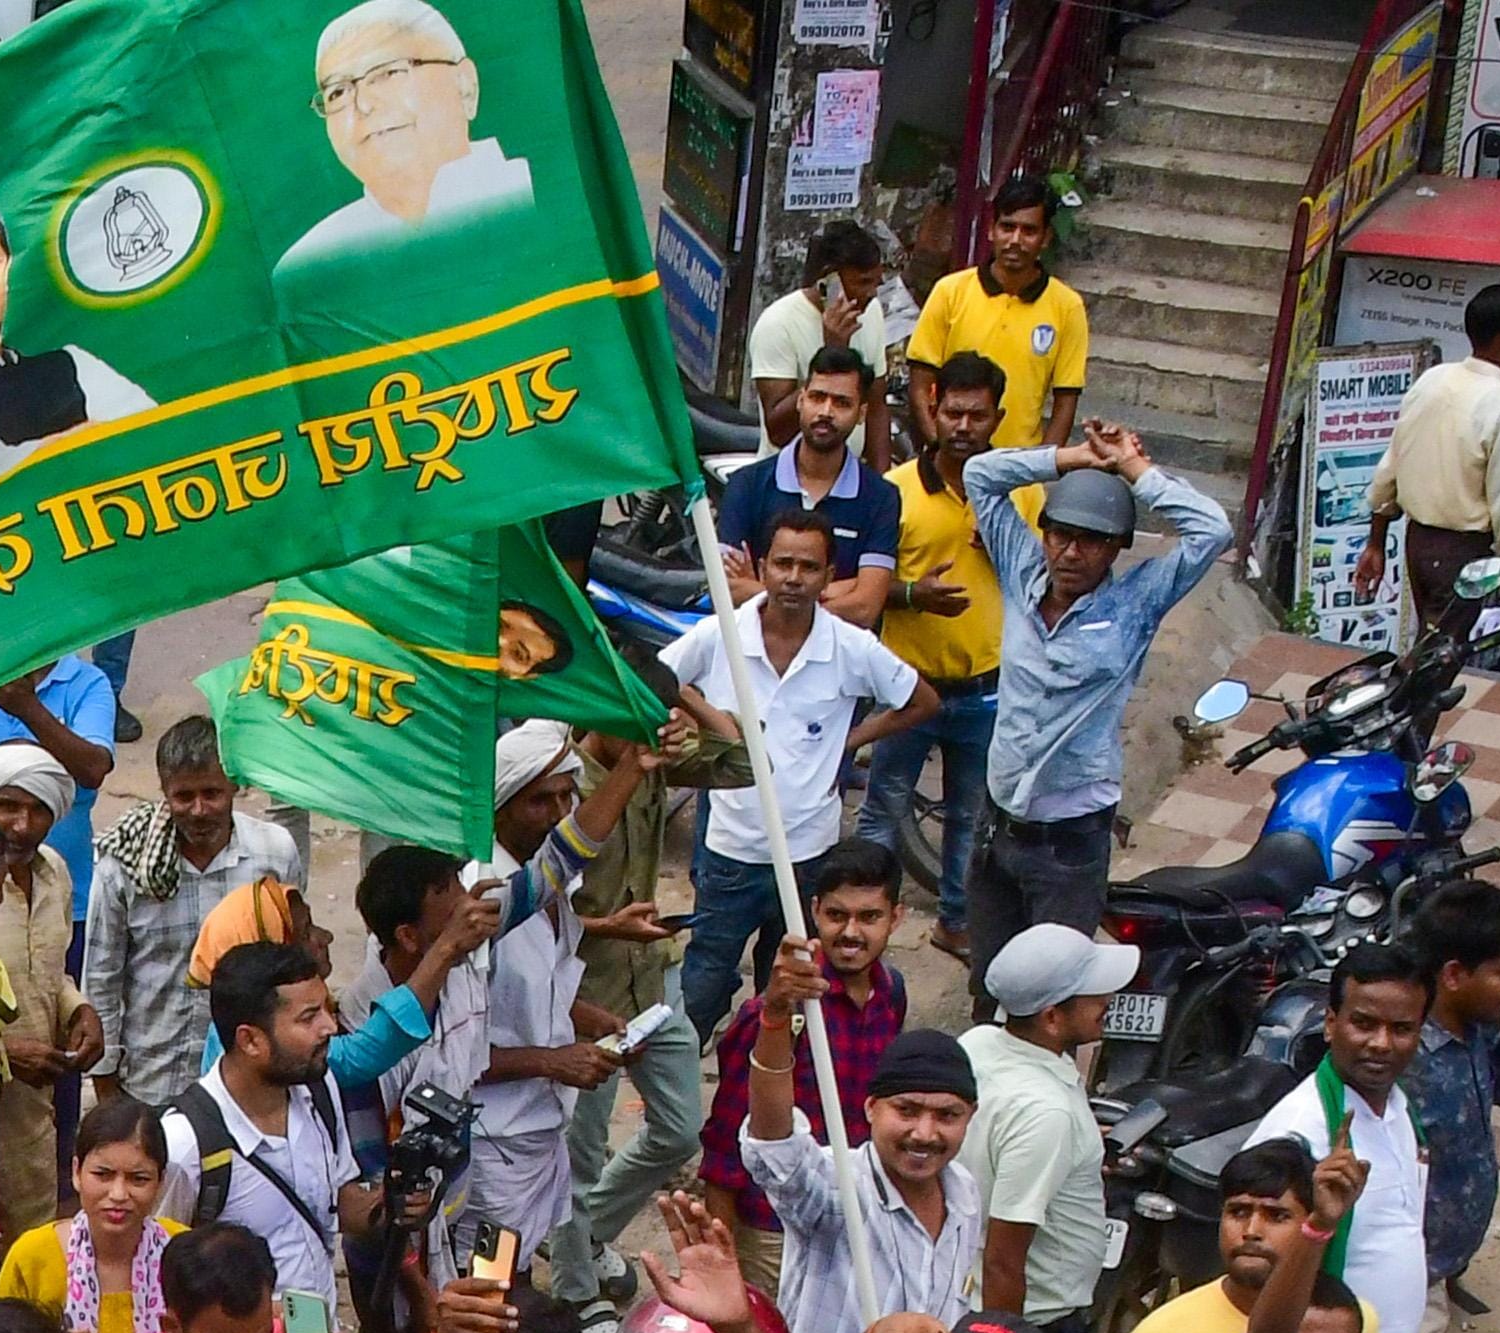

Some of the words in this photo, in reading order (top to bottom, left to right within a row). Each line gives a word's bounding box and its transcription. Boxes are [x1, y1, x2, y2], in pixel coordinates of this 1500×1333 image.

[659, 224, 719, 313] MUCH-MORE
[1367, 267, 1432, 291] X200
[1438, 277, 1467, 297] FE
[1320, 377, 1364, 402] SMART
[1368, 372, 1412, 398] MOBILE
